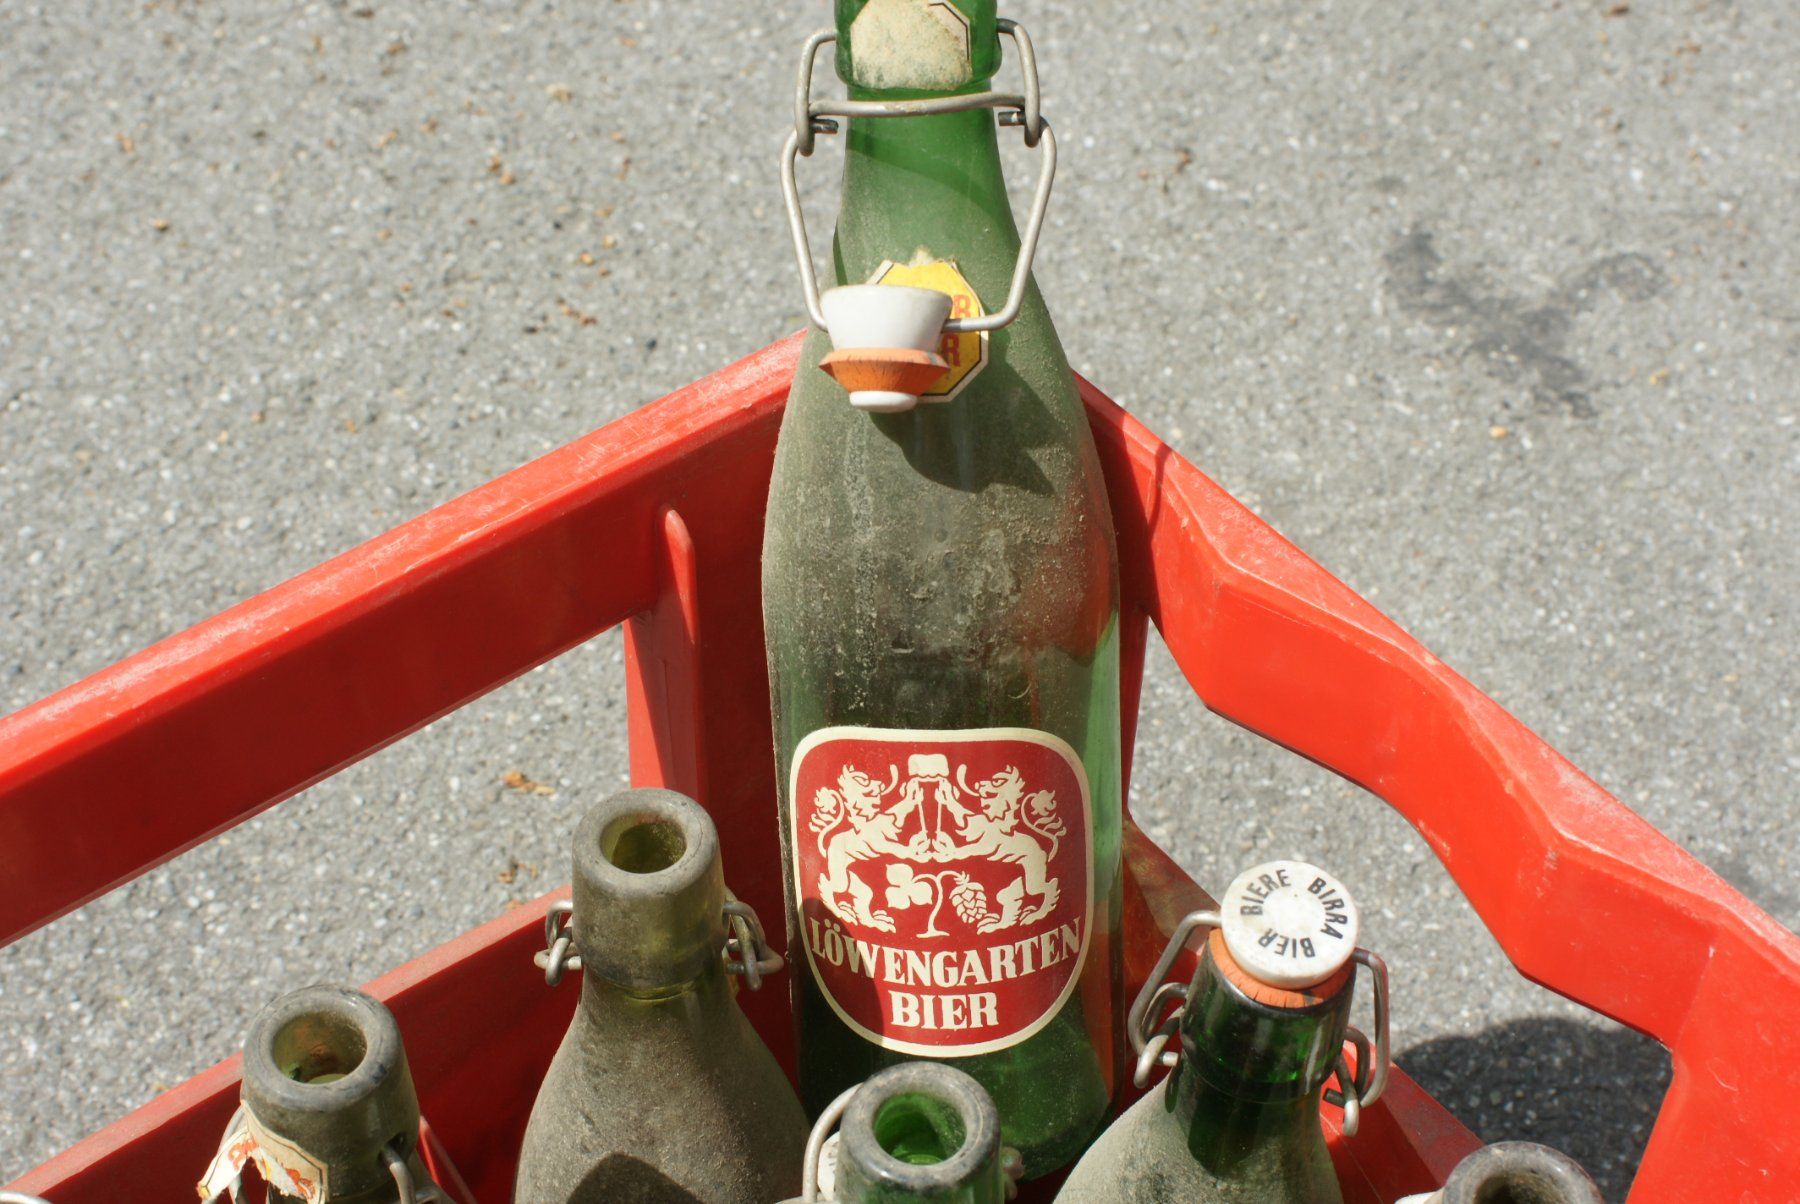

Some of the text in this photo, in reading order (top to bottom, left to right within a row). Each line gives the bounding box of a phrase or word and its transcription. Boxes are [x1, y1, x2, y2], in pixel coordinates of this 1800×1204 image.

[1240, 869, 1291, 915] BIERE
[1307, 877, 1348, 939] BIRRA
[809, 917, 1081, 988] LÖWENGARTEN
[1258, 928, 1315, 958] BIER
[888, 990, 999, 1031] BIER
